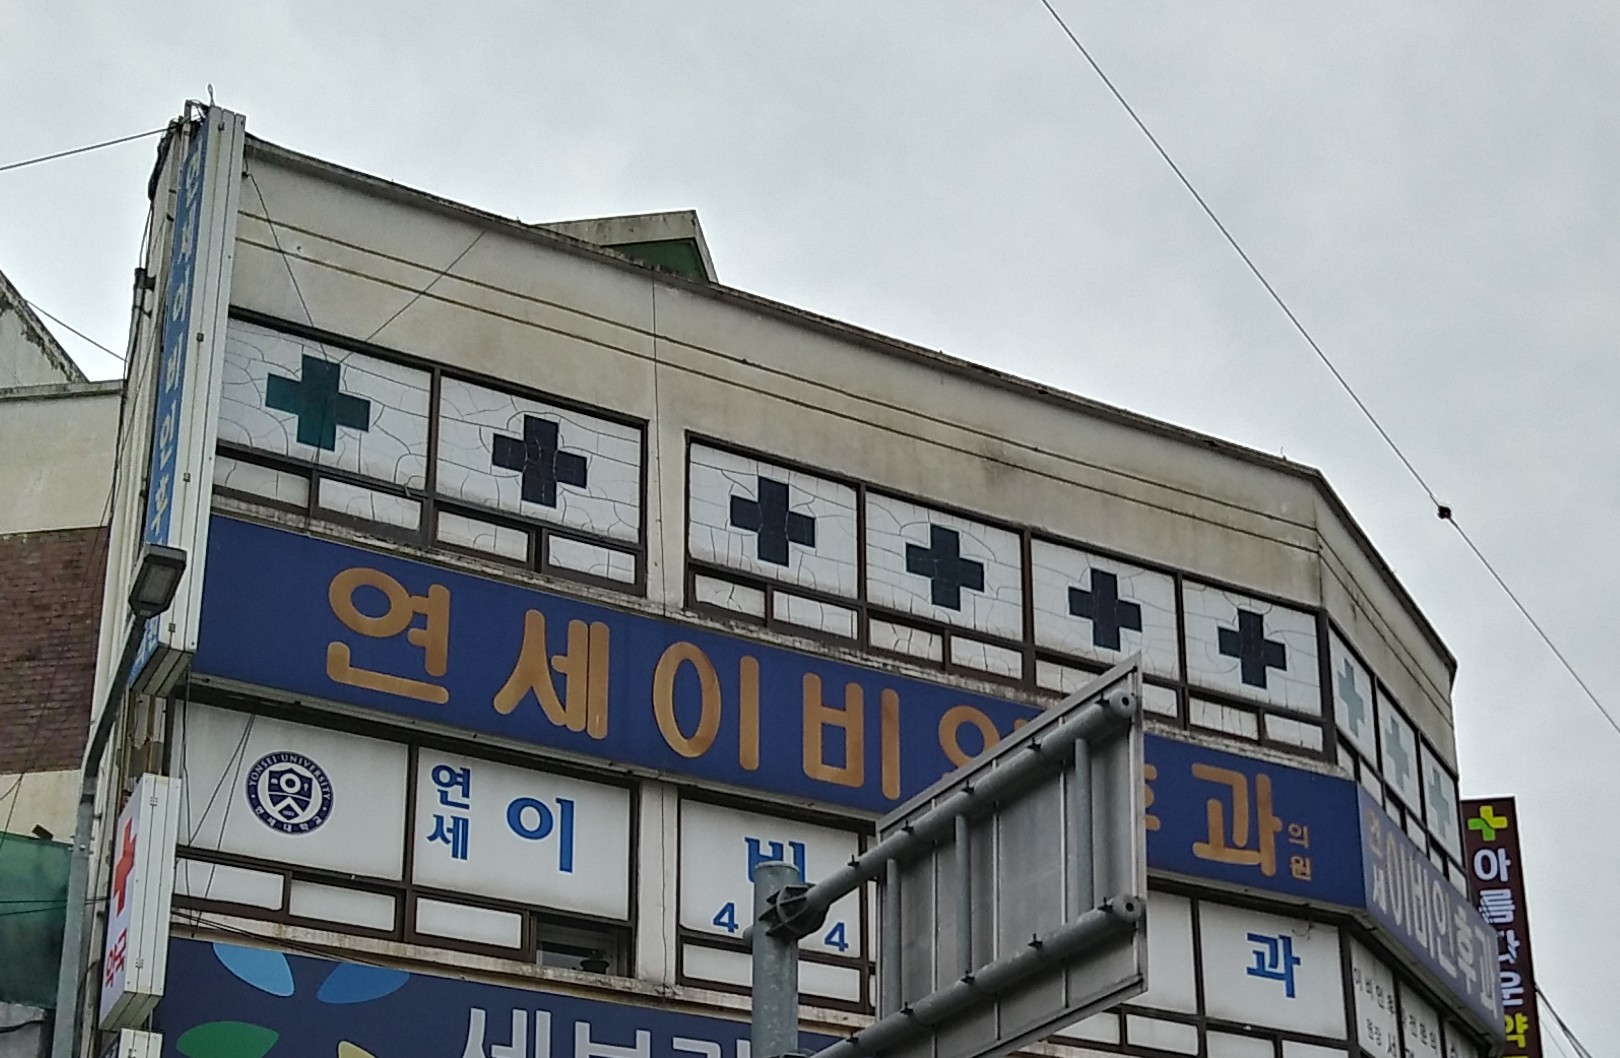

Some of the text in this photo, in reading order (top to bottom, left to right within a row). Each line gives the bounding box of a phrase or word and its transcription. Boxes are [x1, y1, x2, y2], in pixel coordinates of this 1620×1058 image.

[248, 753, 332, 801] YONSEI UNIVERSITY
[1288, 823, 1312, 882] 의원
[427, 763, 471, 861] 연세
[1246, 932, 1301, 998] 과
[713, 902, 849, 952] 4 4
